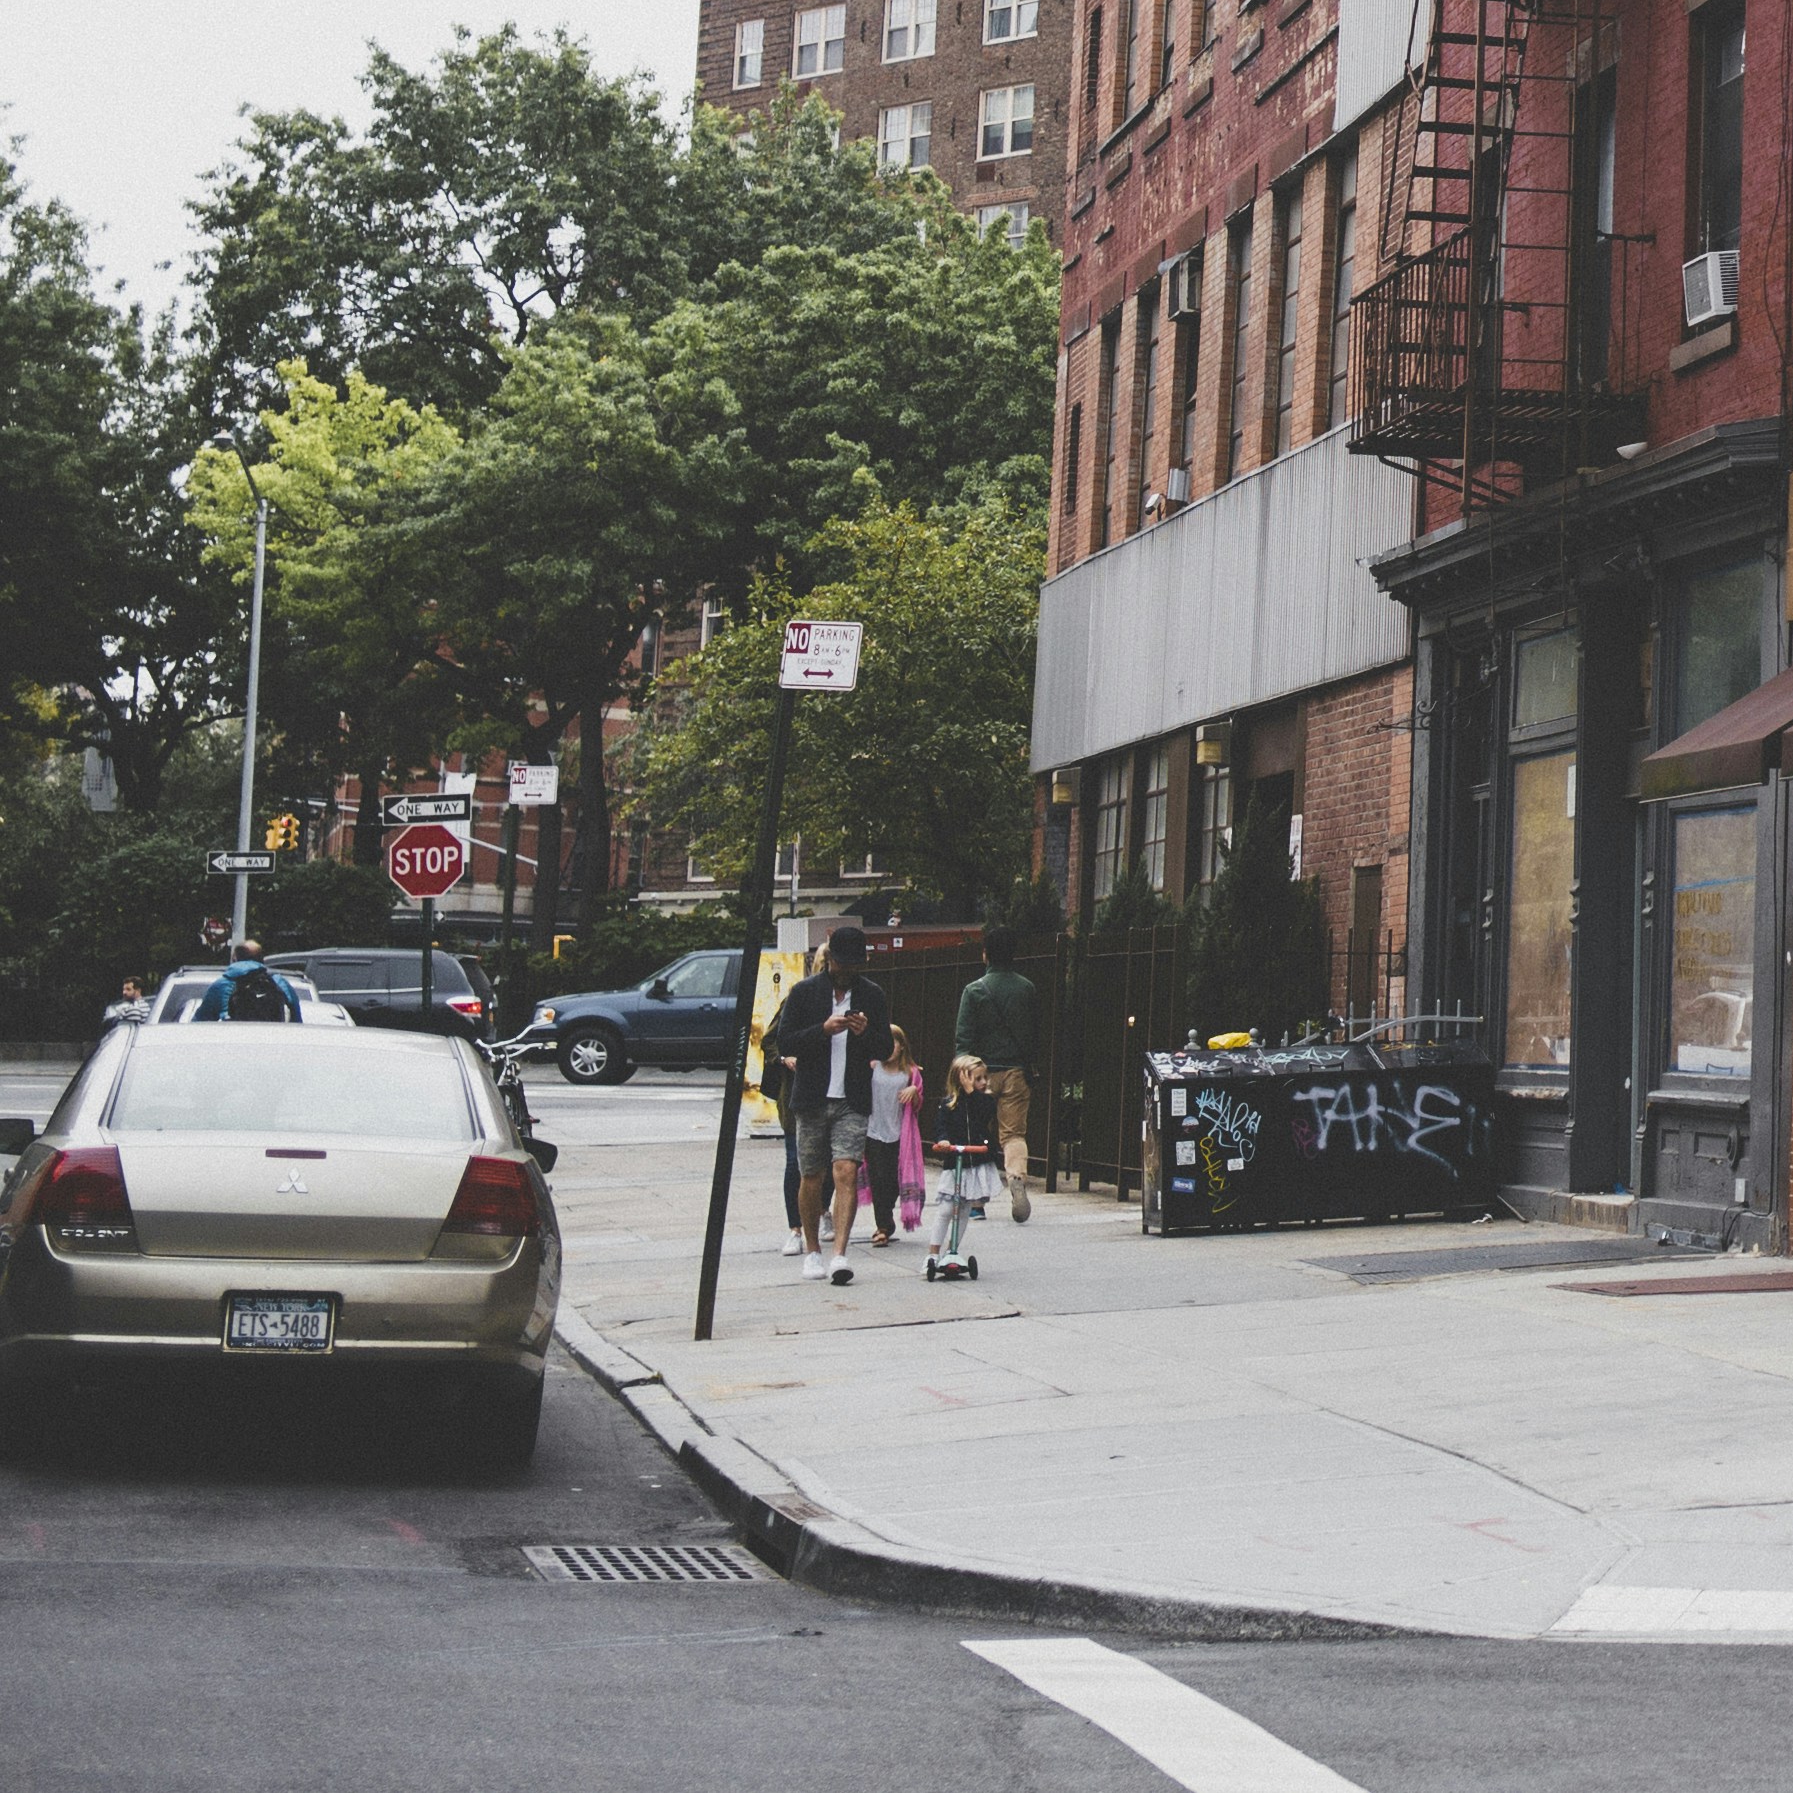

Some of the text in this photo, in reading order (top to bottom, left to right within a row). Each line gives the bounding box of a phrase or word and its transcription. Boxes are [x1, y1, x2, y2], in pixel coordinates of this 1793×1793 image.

[787, 627, 855, 650] NO PARKING
[512, 769, 526, 783] NO
[397, 802, 460, 816] ONE WAY
[218, 857, 266, 867] ONE WAY
[395, 846, 459, 876] STOP
